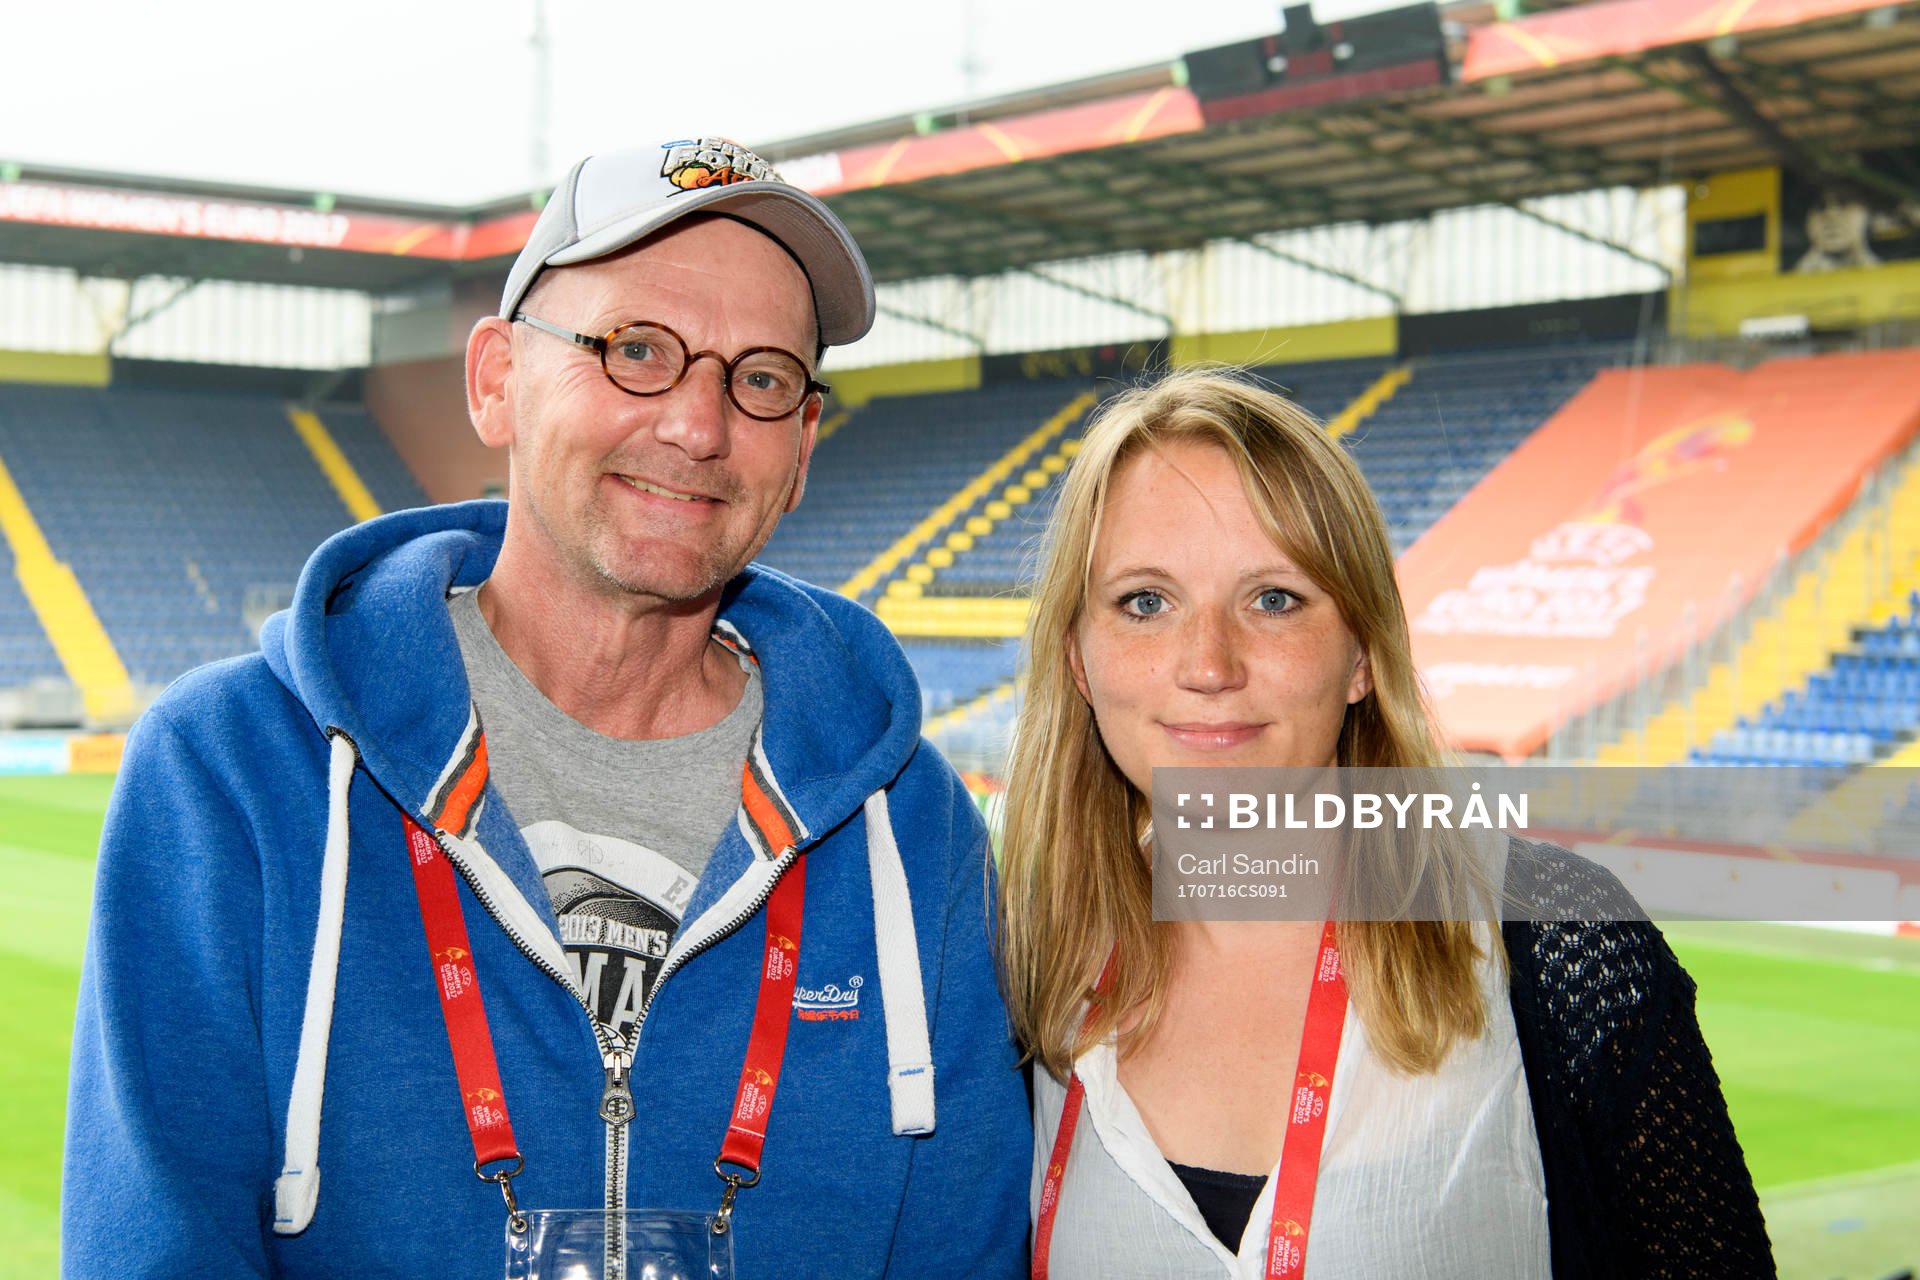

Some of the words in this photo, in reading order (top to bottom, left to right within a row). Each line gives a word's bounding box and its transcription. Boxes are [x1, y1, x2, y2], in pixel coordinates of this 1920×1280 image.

[416, 831, 424, 848] EURO
[419, 849, 427, 863] 2017
[559, 914, 602, 942] 2013
[605, 919, 668, 957] MEN'S
[776, 952, 784, 980] WOMEN'S
[1326, 948, 1334, 965] EURO
[444, 964, 453, 981] EURO
[1330, 952, 1339, 981] WOMEN'S
[451, 964, 463, 995] WOMEN'S
[448, 982, 457, 998] 2017
[793, 984, 859, 1004] uperDry
[746, 1083, 754, 1101] EURO
[1300, 1088, 1308, 1105] EURO
[740, 1103, 749, 1120] 2017
[747, 1088, 759, 1119] WOMEN'S
[1304, 1091, 1313, 1122] WOMEN'S
[476, 1105, 485, 1124] EURO
[1282, 1240, 1290, 1274] WOMEN'S
